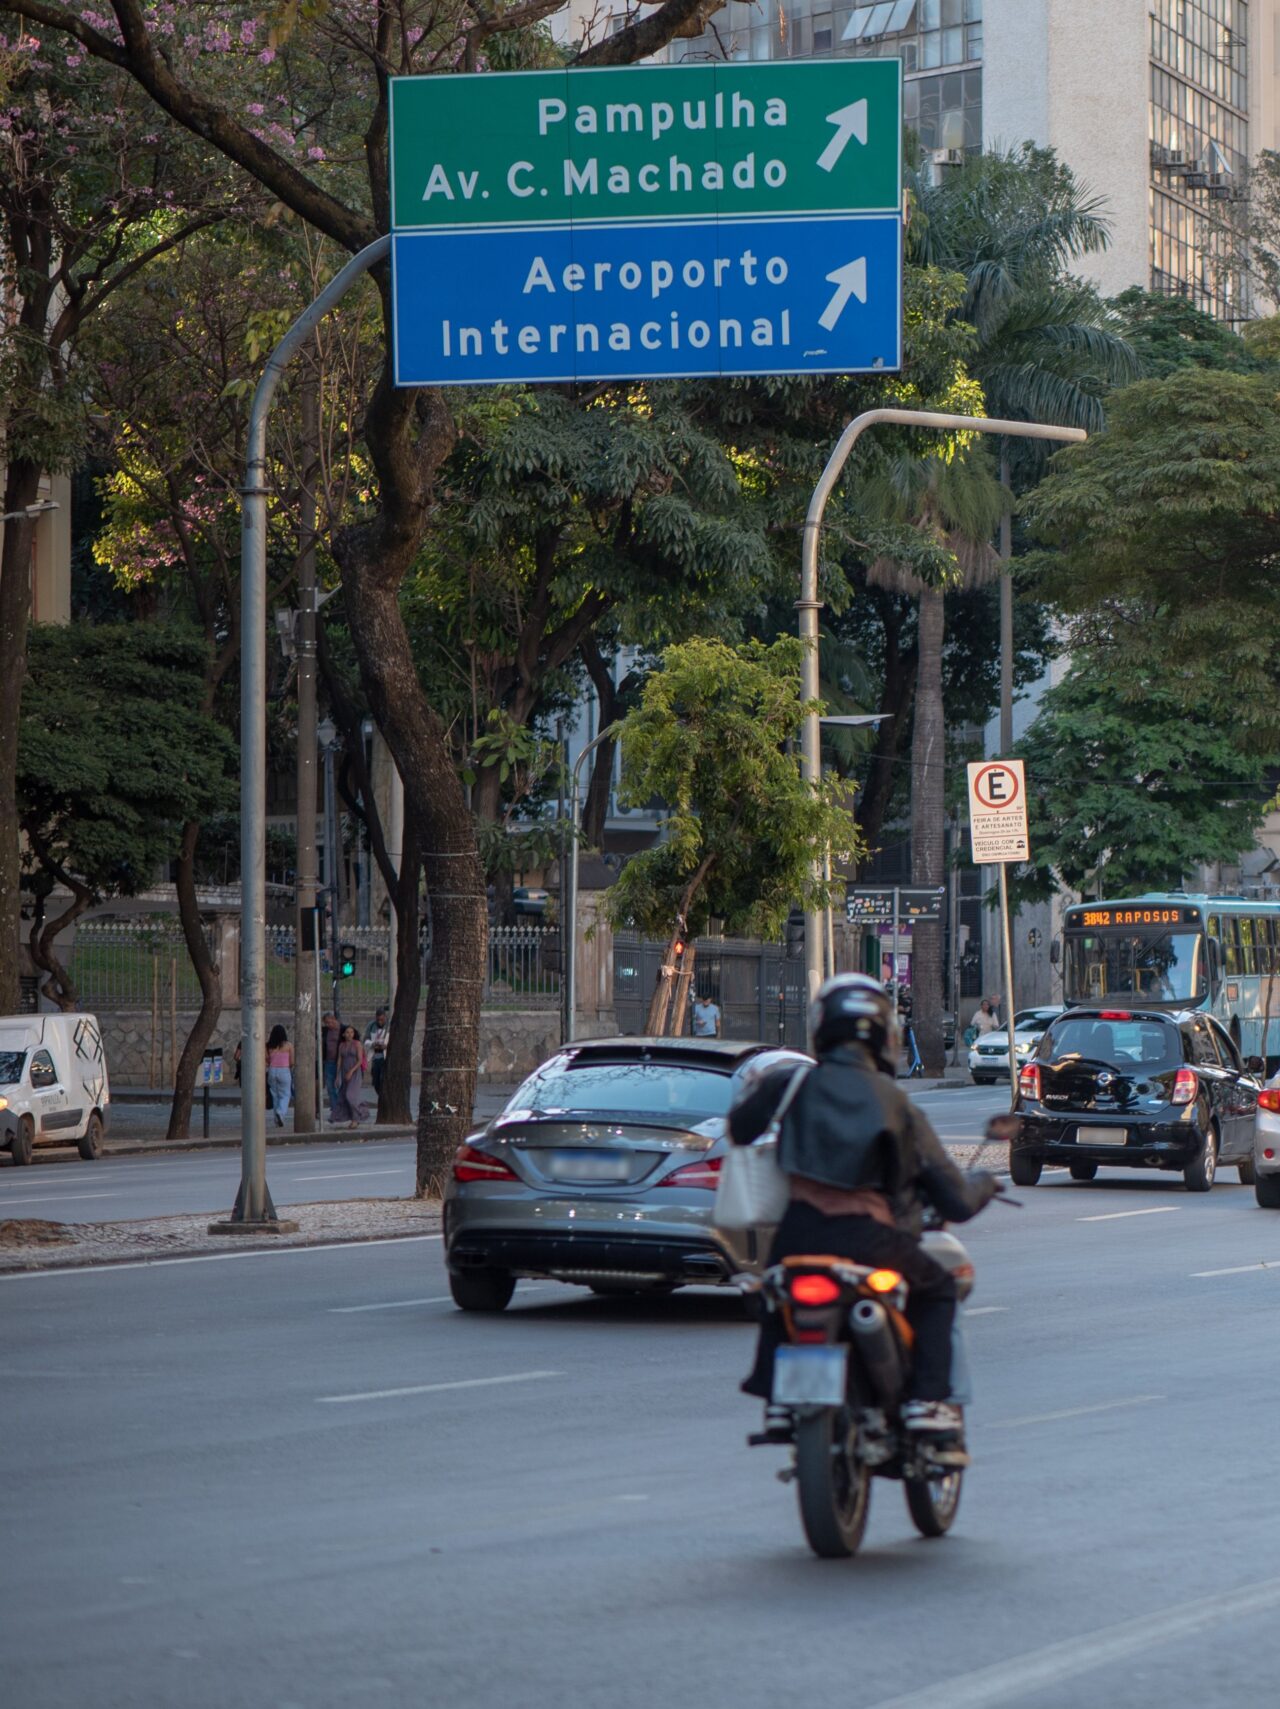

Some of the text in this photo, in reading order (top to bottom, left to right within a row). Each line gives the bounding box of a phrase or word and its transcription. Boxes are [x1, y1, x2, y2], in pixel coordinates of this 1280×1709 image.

[538, 91, 789, 141] Pampulha
[421, 151, 789, 202] Av. C. Machado
[521, 249, 790, 299] Aeroporto
[441, 308, 791, 358] Internacional
[988, 772, 1006, 800] E
[981, 822, 1022, 830] ARTESANATO
[1083, 910, 1179, 926] 3842 RAPOSOS
